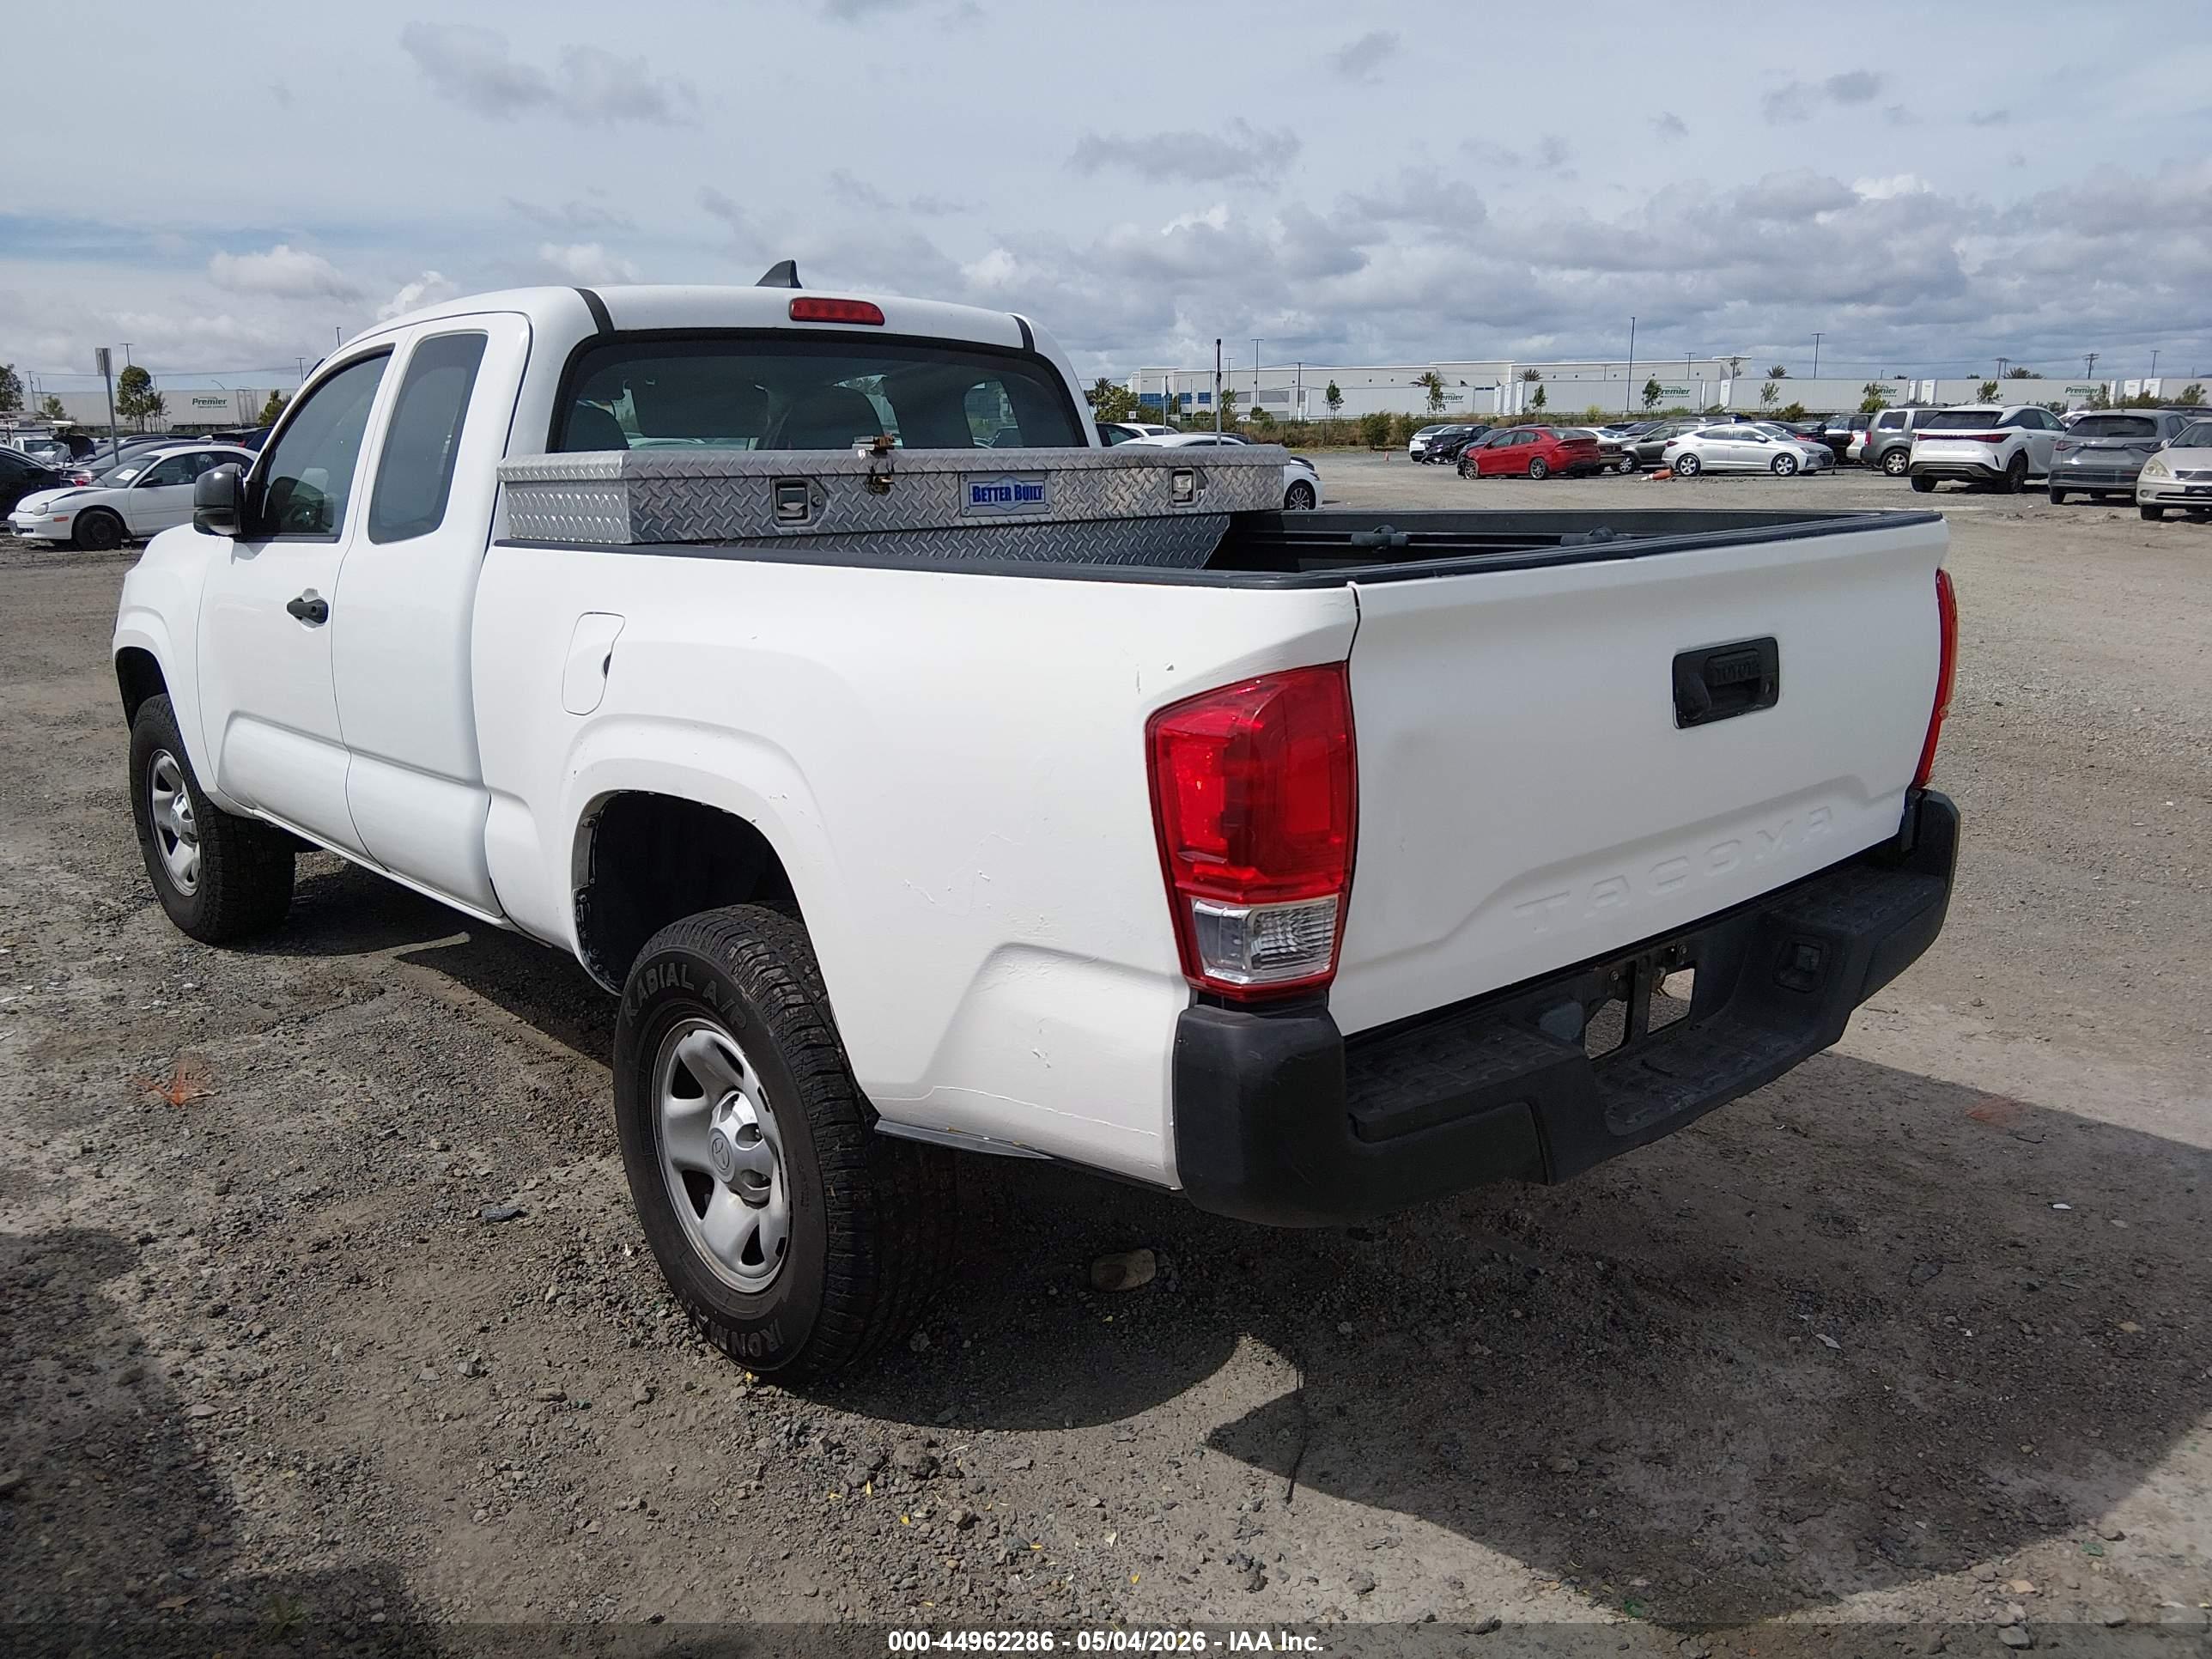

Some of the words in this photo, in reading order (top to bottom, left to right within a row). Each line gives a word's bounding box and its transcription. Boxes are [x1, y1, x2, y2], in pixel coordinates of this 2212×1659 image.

[972, 485, 1012, 502] BETTER
[1014, 484, 1042, 501] BUILT
[1513, 805, 1833, 933] TACOMA
[623, 962, 695, 1028] RADIAL
